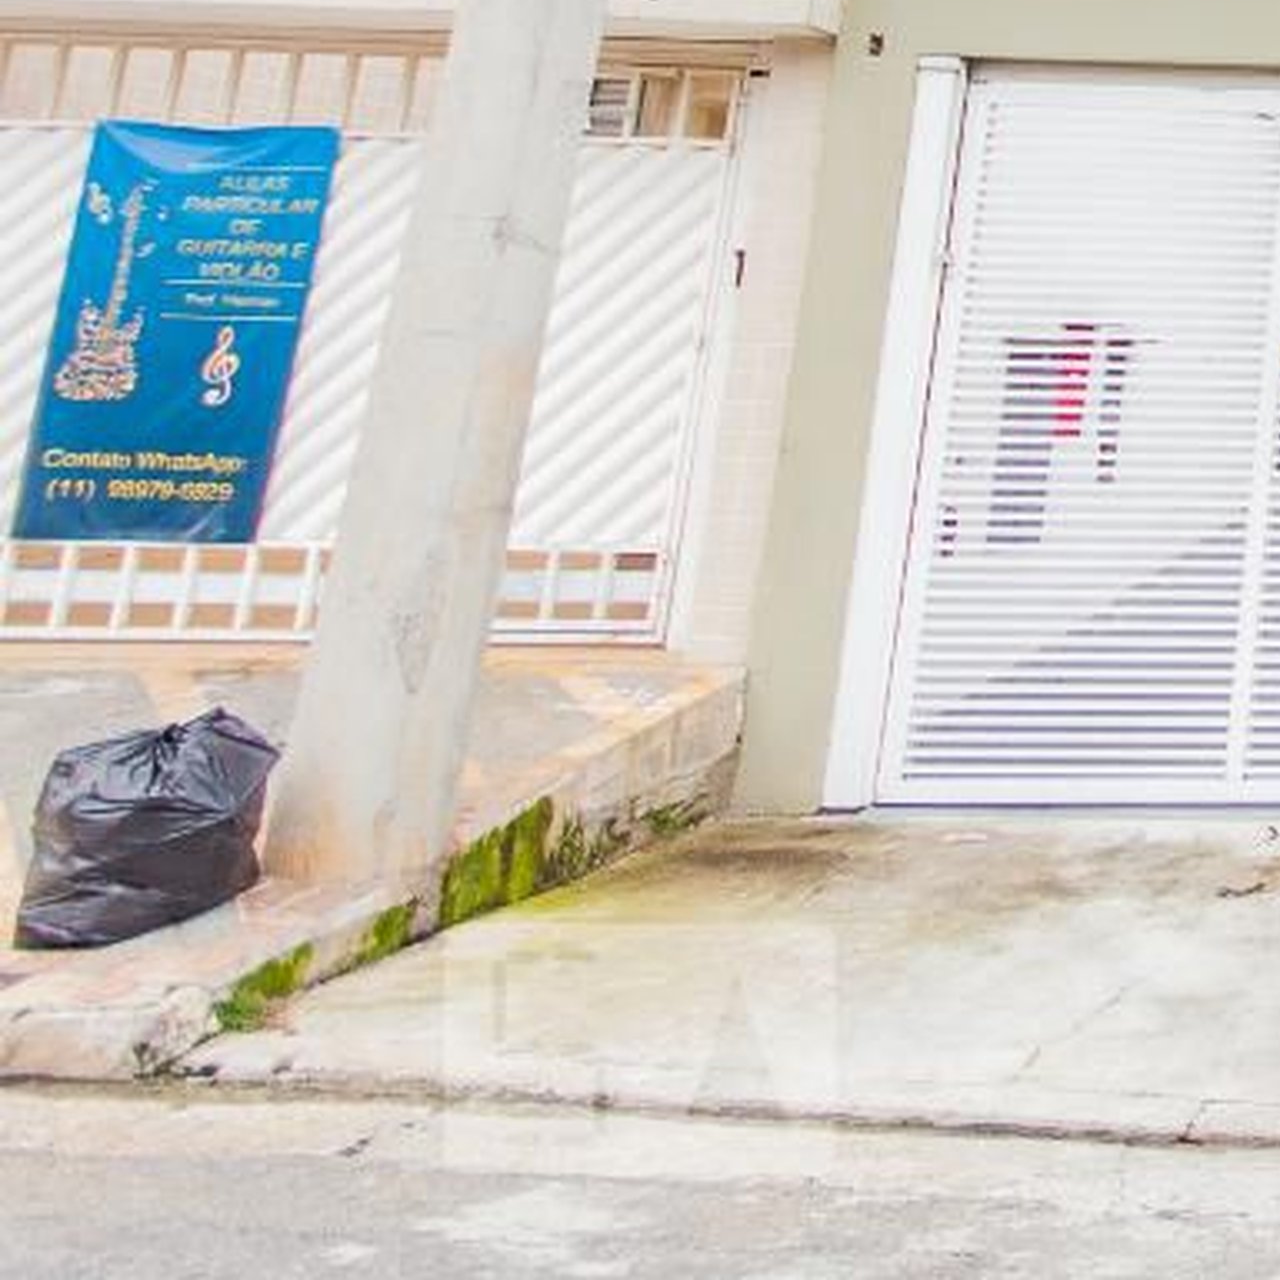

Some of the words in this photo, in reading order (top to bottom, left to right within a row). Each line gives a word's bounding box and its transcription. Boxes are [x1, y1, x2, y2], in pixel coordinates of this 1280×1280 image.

[218, 175, 292, 192] AULAS
[181, 195, 320, 215] PARTICULAR
[229, 218, 264, 235] DE
[177, 238, 288, 259] GUITARRA
[291, 241, 311, 260] E
[199, 259, 281, 281] VIOLÃO
[43, 448, 132, 468] Contato
[45, 478, 97, 502] (11)
